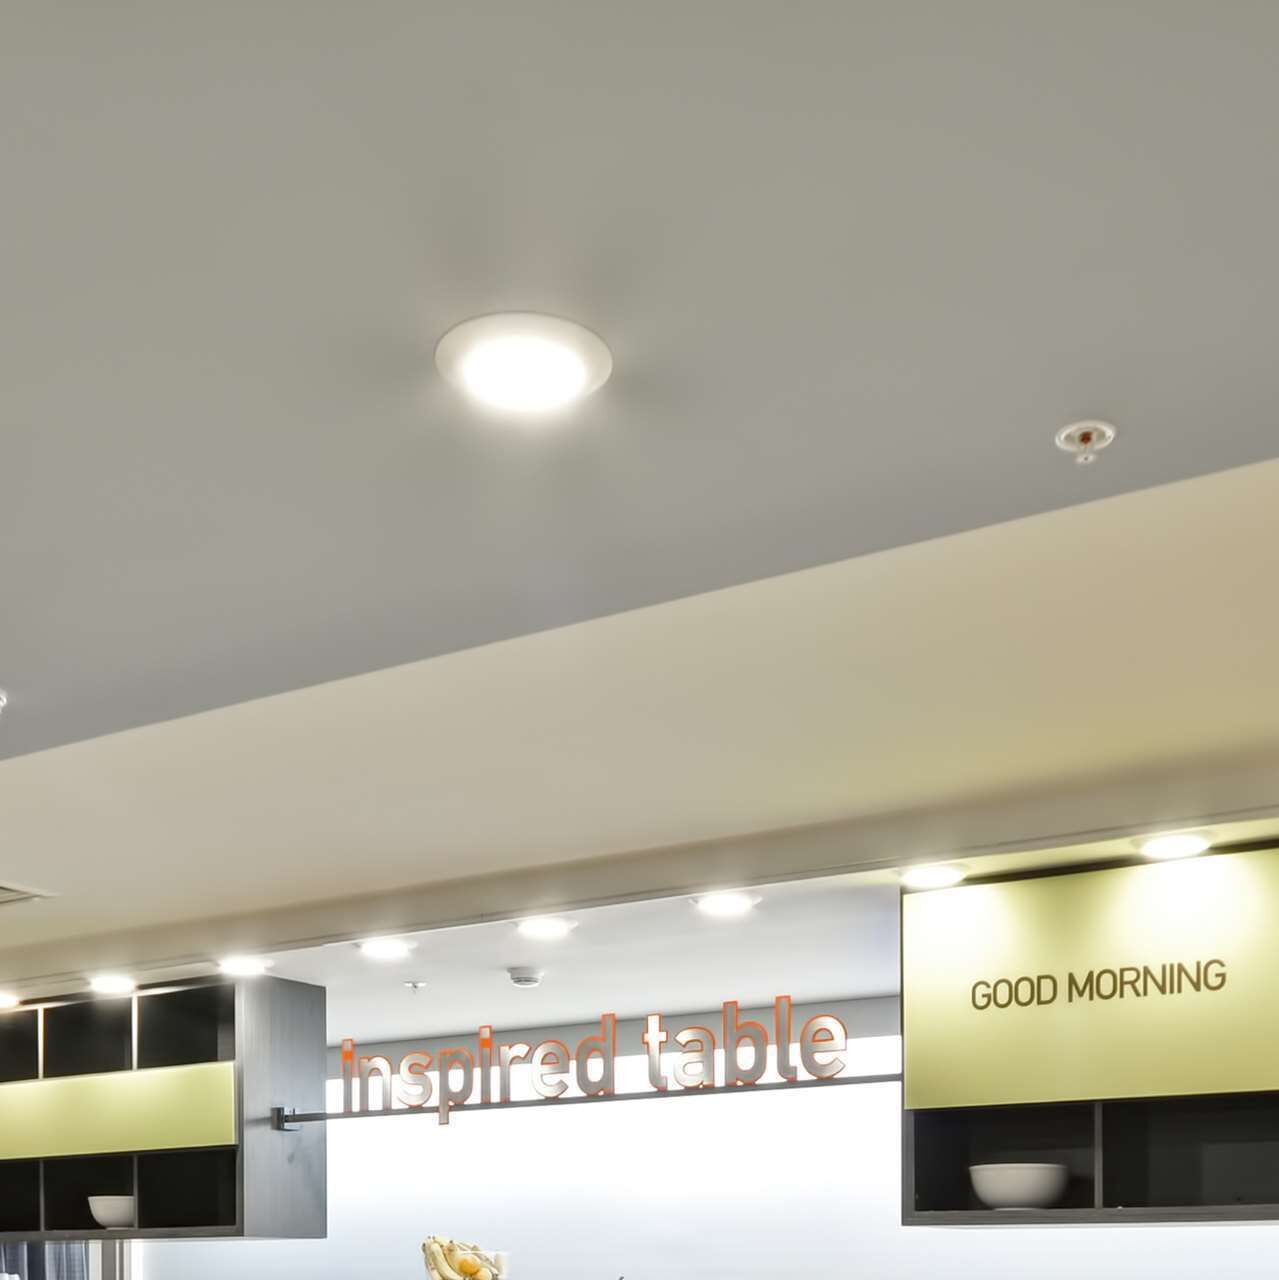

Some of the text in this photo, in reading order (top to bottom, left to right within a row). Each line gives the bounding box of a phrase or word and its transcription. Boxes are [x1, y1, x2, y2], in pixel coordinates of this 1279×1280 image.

[970, 958, 1227, 1011] GOOD MORNING
[341, 994, 848, 1125] inspired table
